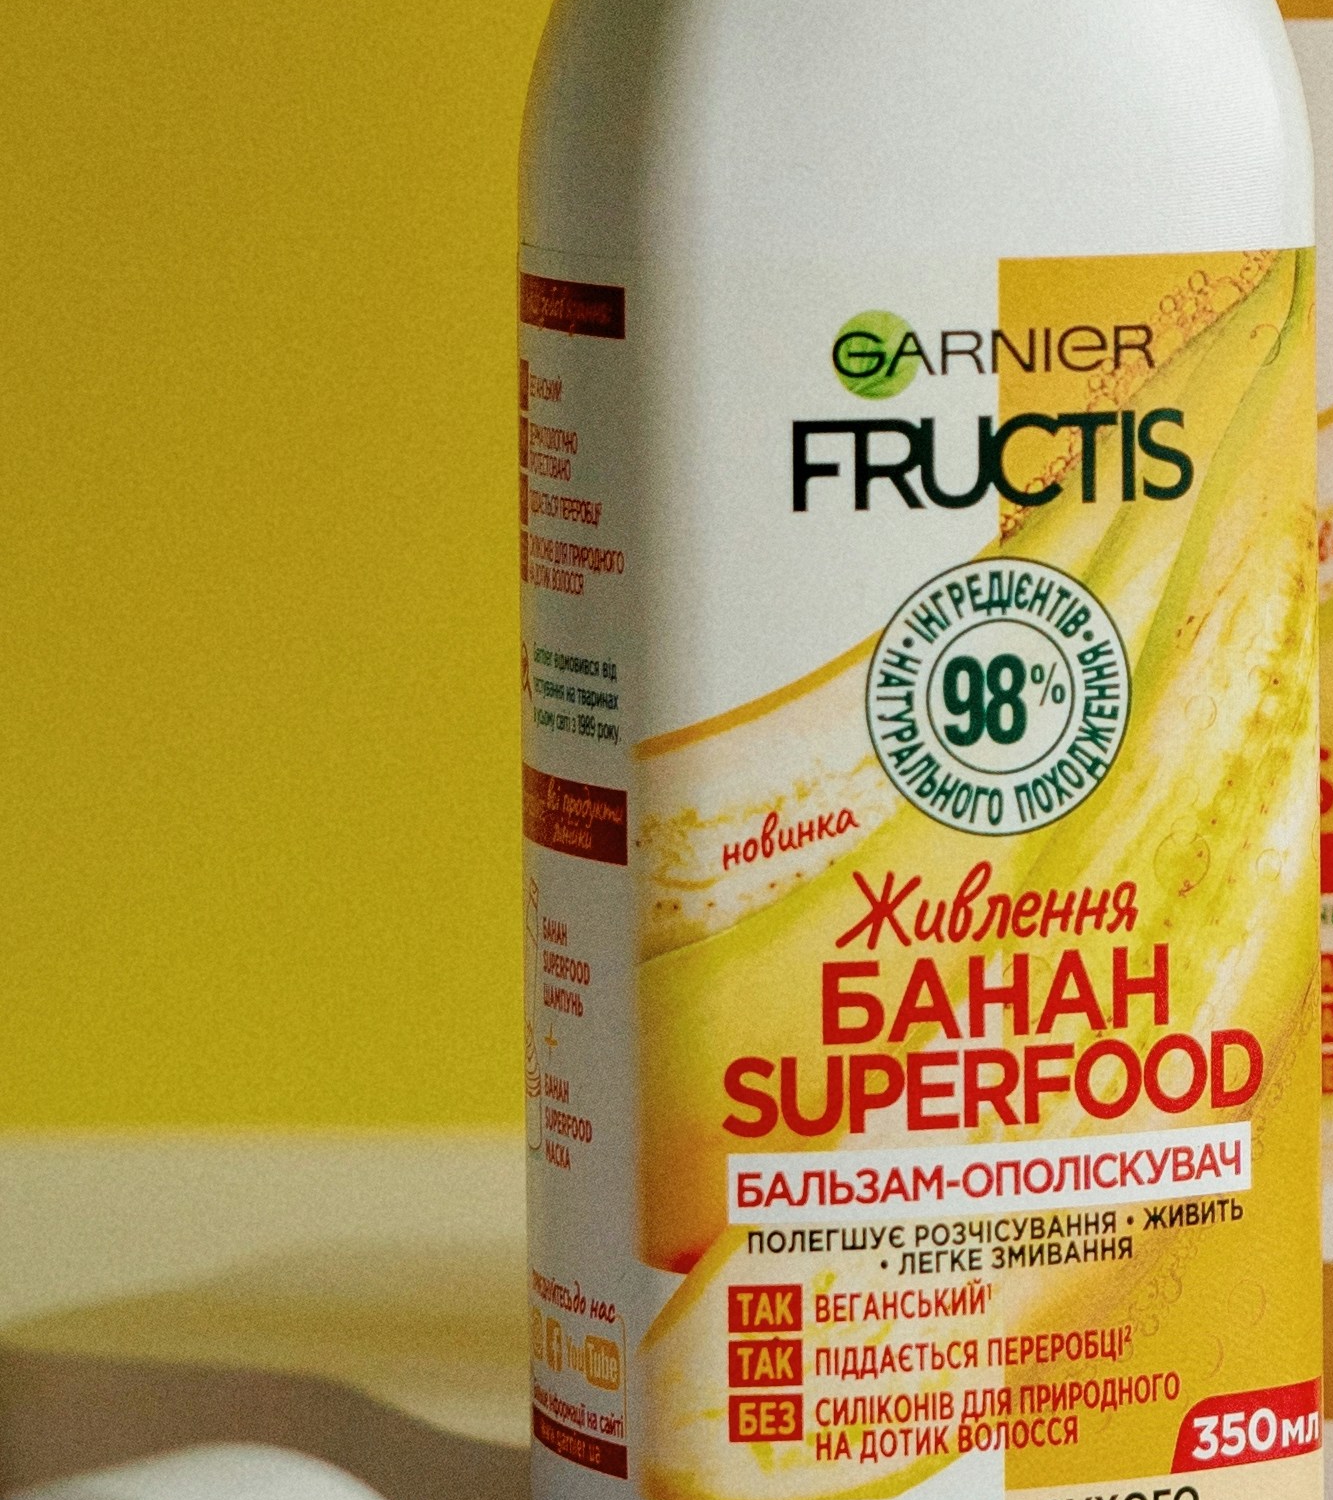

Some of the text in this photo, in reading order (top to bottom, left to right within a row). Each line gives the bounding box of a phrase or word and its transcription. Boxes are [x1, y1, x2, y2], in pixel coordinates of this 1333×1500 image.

[832, 324, 1155, 378] GARNIER
[792, 408, 1194, 512] FRUCTIS
[904, 570, 1092, 644] ІНГРЕДІЄНТІВ
[602, 657, 617, 682] від
[577, 687, 619, 711] тваринах
[577, 714, 596, 738] 1989
[876, 640, 1120, 826] НАТУРАЛЬНОГО ПОХОДЖЕННЯ
[722, 808, 860, 871] новинка
[835, 860, 1139, 950] Живлення
[542, 949, 591, 986] SUPERFOOD
[543, 983, 584, 1018] ШАМПУНЬ
[821, 943, 1169, 1045] БАНАН
[721, 1028, 1264, 1138] SUPERFOOD
[544, 1106, 593, 1144] SUPERFOOD
[737, 1140, 1242, 1209] БАЛЬЗАМ-ОПОЛІСКУВАЧ
[747, 1197, 1245, 1255] ПОЛЕГШУЄ РОЗЧІСУВАННЯ ЖИВИТЬ
[898, 1237, 1134, 1275] ЛЕГКЕ ЗМИВАННЯ
[573, 1280, 587, 1315] до
[590, 1298, 616, 1324] нас
[738, 1293, 795, 1325] ТАК
[566, 1333, 619, 1385] YouTube
[738, 1348, 795, 1380] ТАК
[816, 1343, 979, 1381] ПІДДАЄТЬСЯ
[587, 1409, 597, 1431] на
[600, 1411, 624, 1439] сайті
[738, 1371, 1180, 1436] БЕЗ СИЛІКОНІВ ДЛЯ ПРИРОДНОГО
[816, 1416, 1079, 1464] НА ДОТИК ВОЛОССЯ
